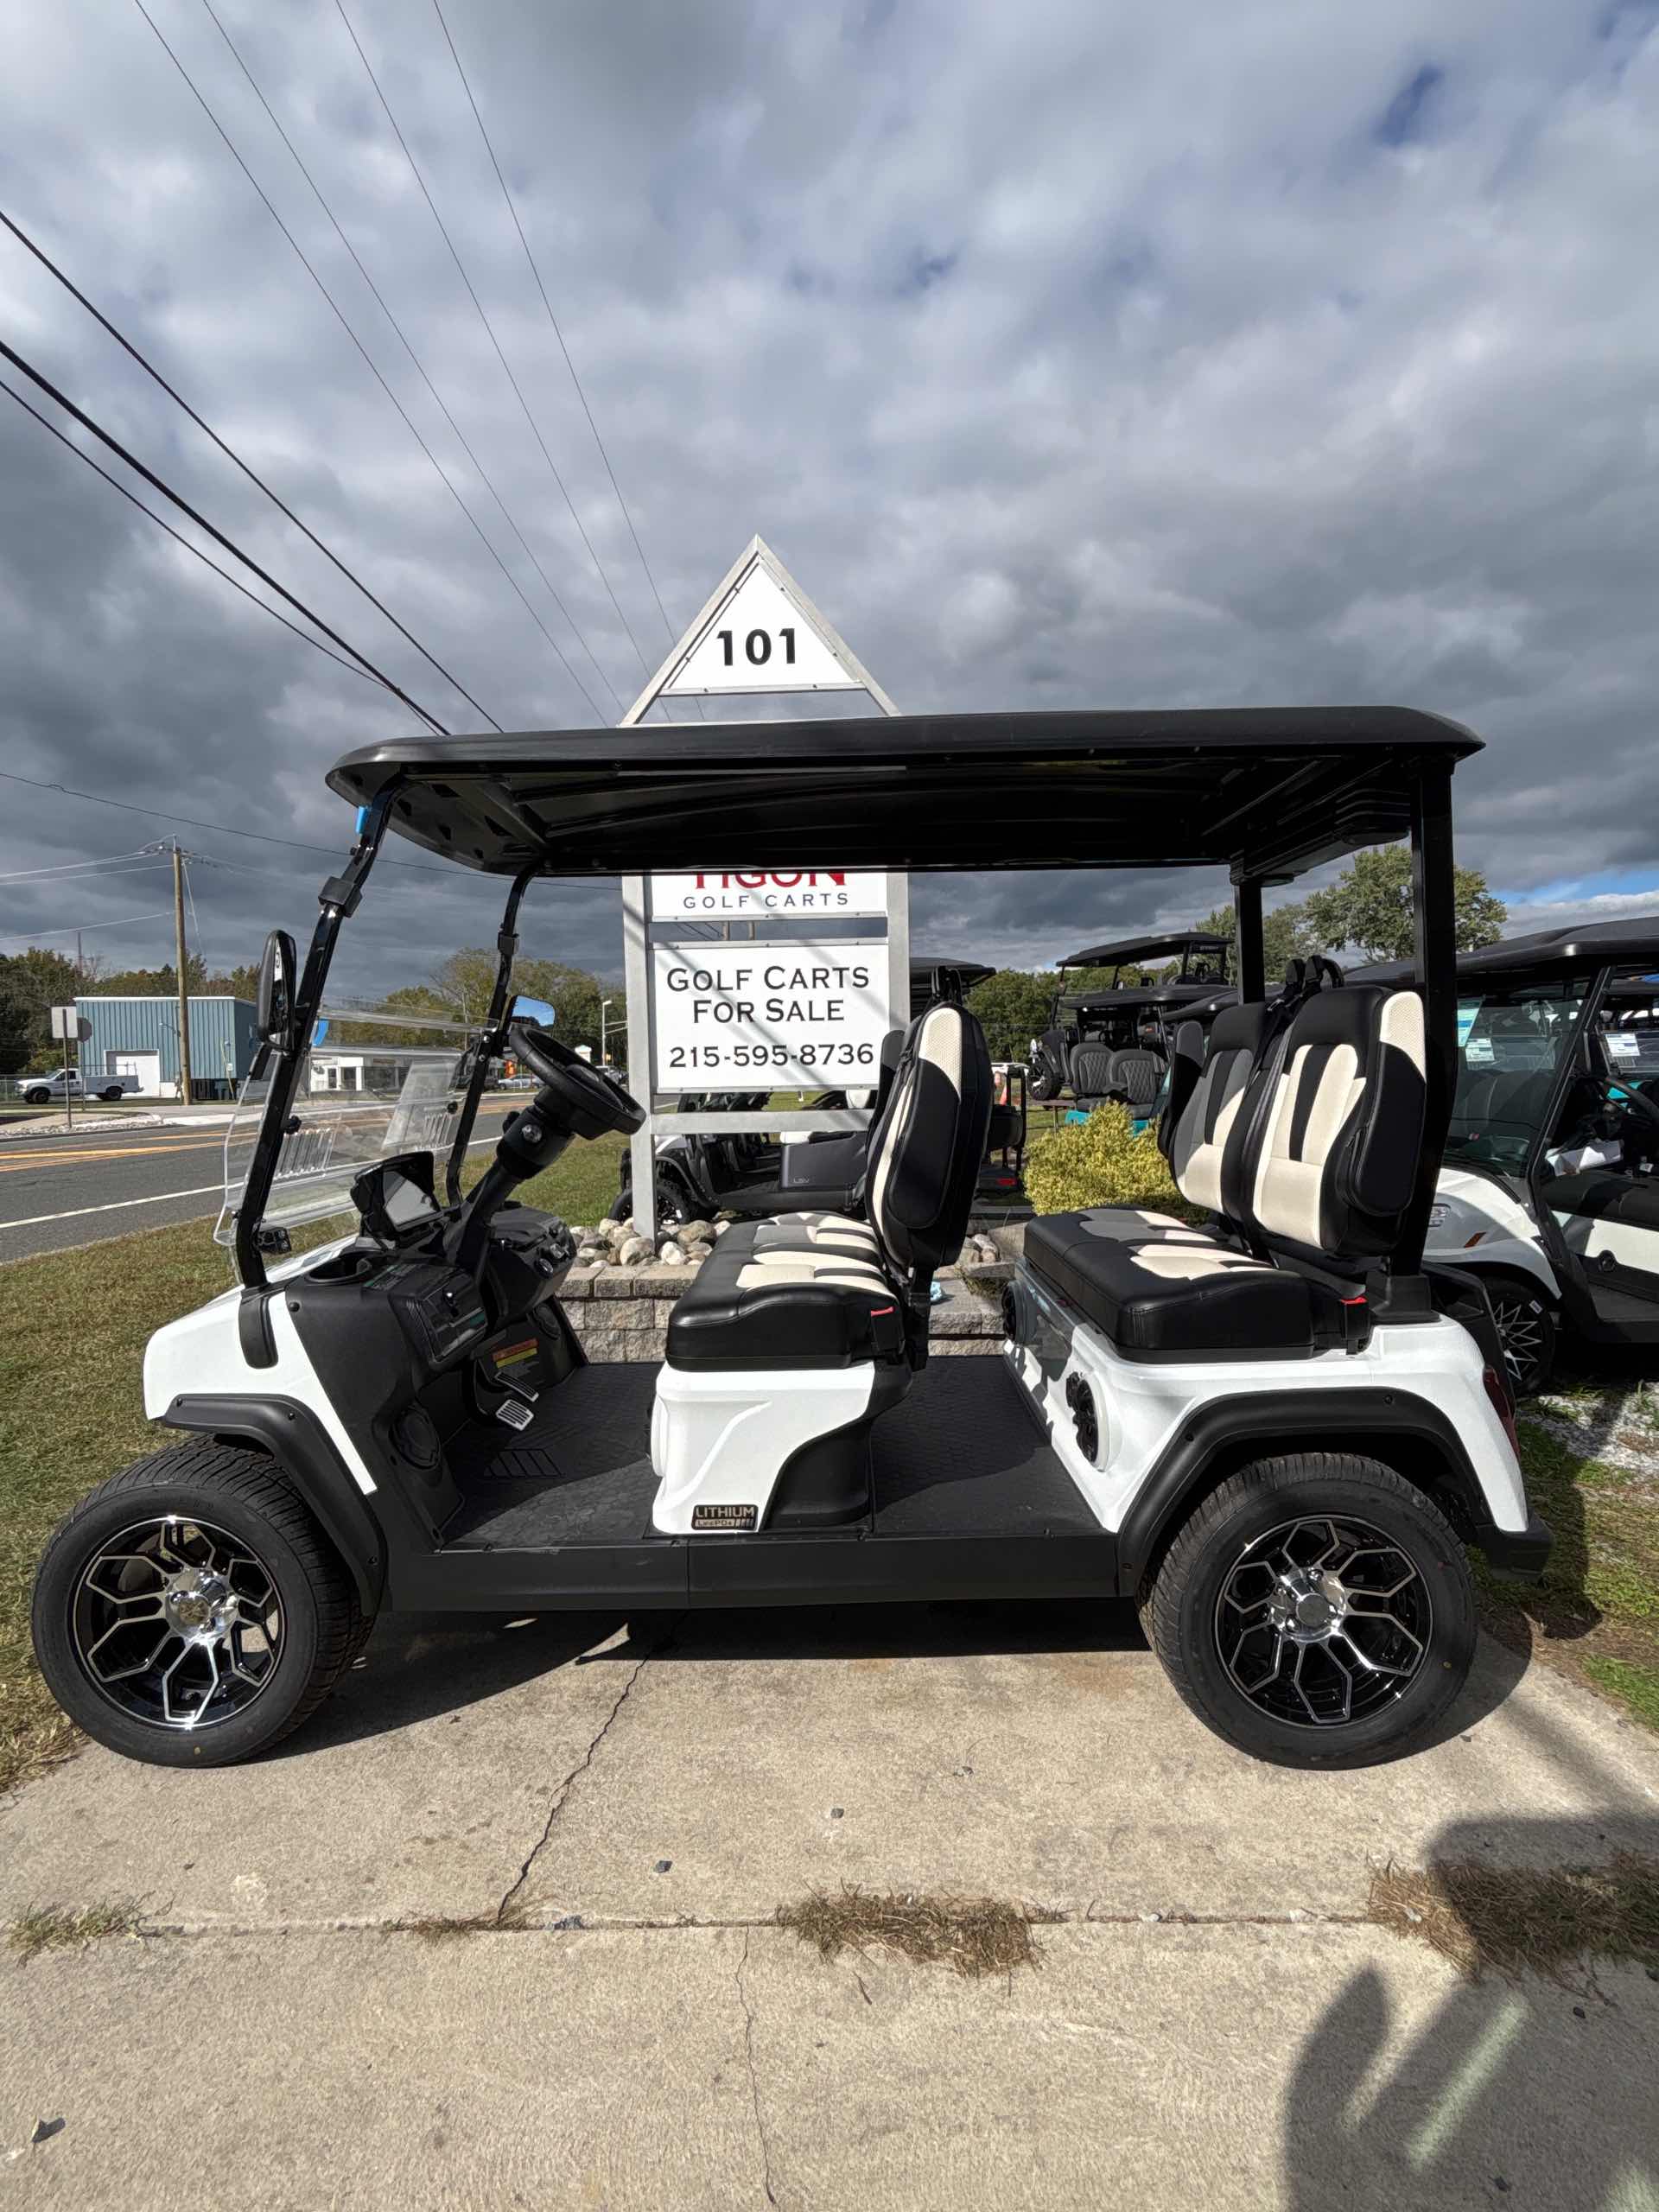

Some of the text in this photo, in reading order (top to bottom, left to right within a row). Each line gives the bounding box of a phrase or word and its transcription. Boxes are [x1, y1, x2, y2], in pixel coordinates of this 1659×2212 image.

[716, 627, 796, 666] 101
[683, 893, 849, 909] GOLF CARTS
[667, 965, 869, 992] GOLF CARTS
[693, 997, 844, 1023] FOR SALE
[670, 1043, 874, 1068] 215-595-8736
[696, 1506, 754, 1518] LITHIUM
